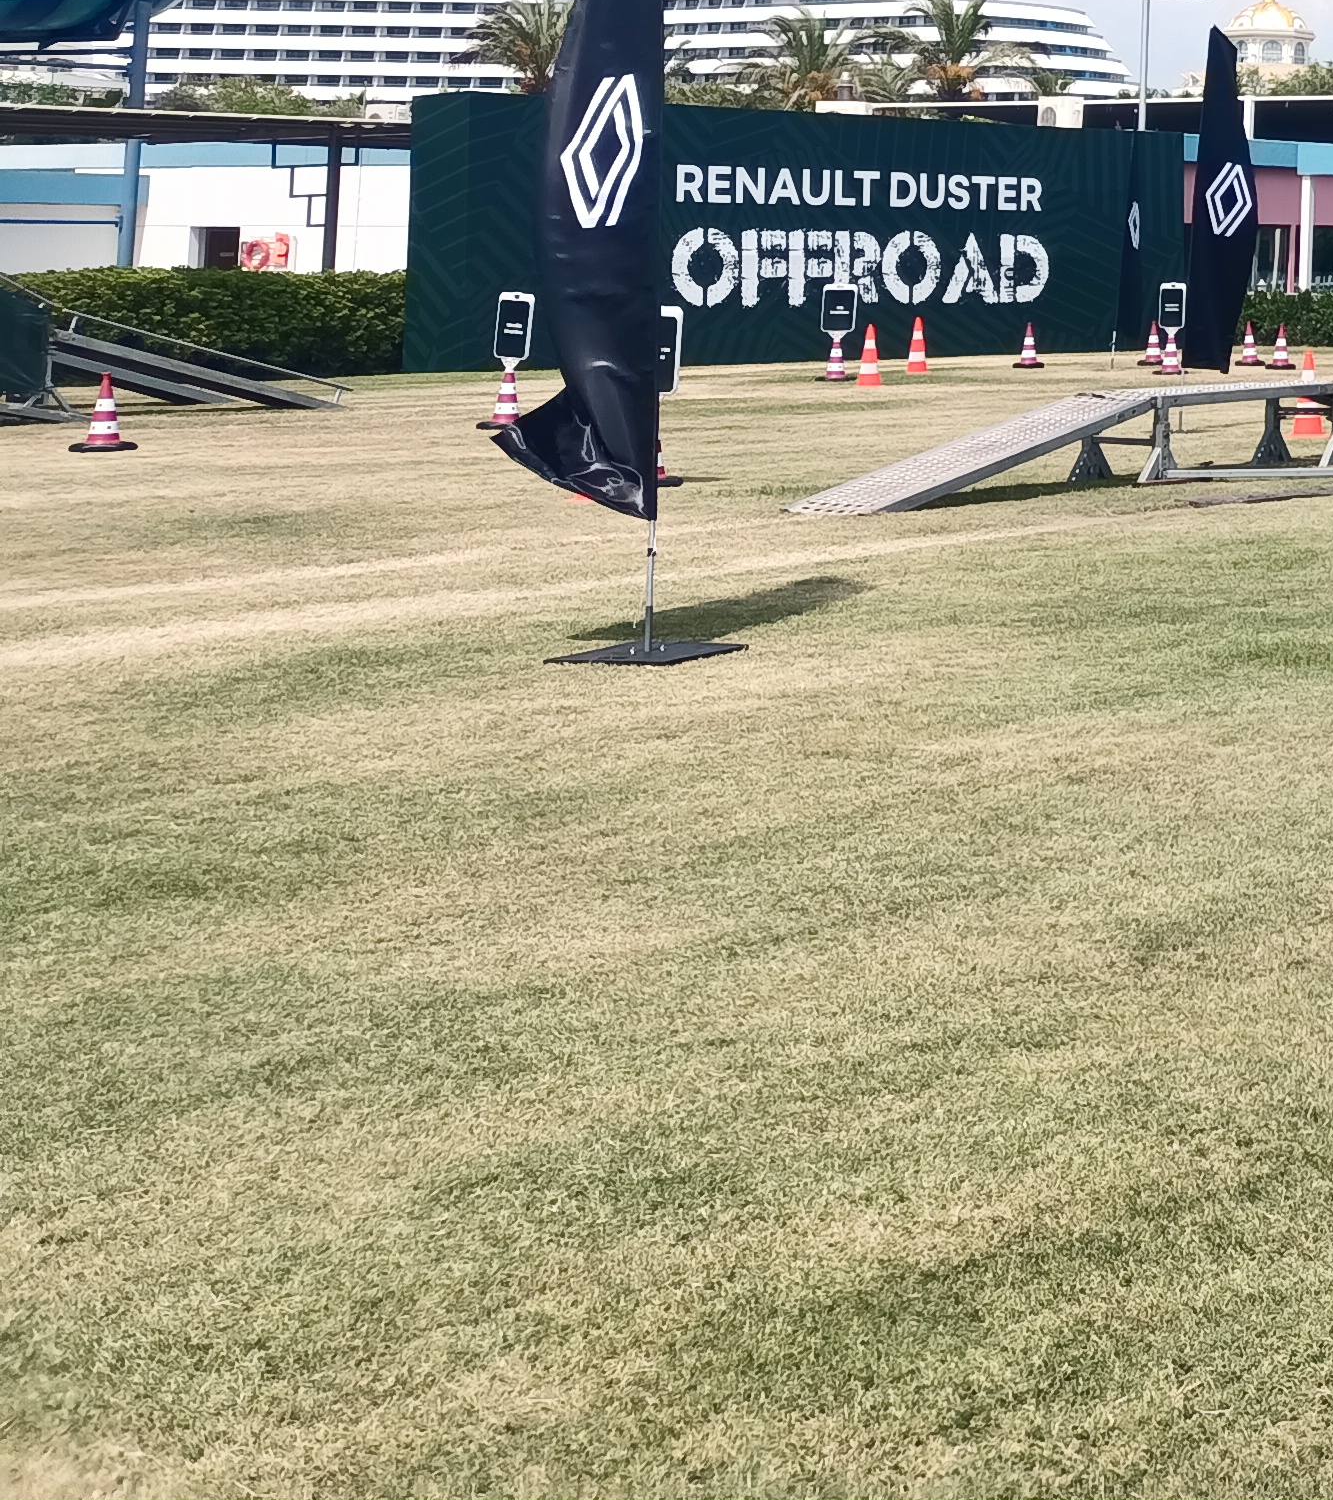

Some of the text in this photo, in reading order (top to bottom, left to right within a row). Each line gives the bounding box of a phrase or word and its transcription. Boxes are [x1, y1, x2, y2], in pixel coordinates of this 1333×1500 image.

[675, 163, 1043, 212] RENAULT DUSTER
[671, 226, 1050, 309] OFFROAD
